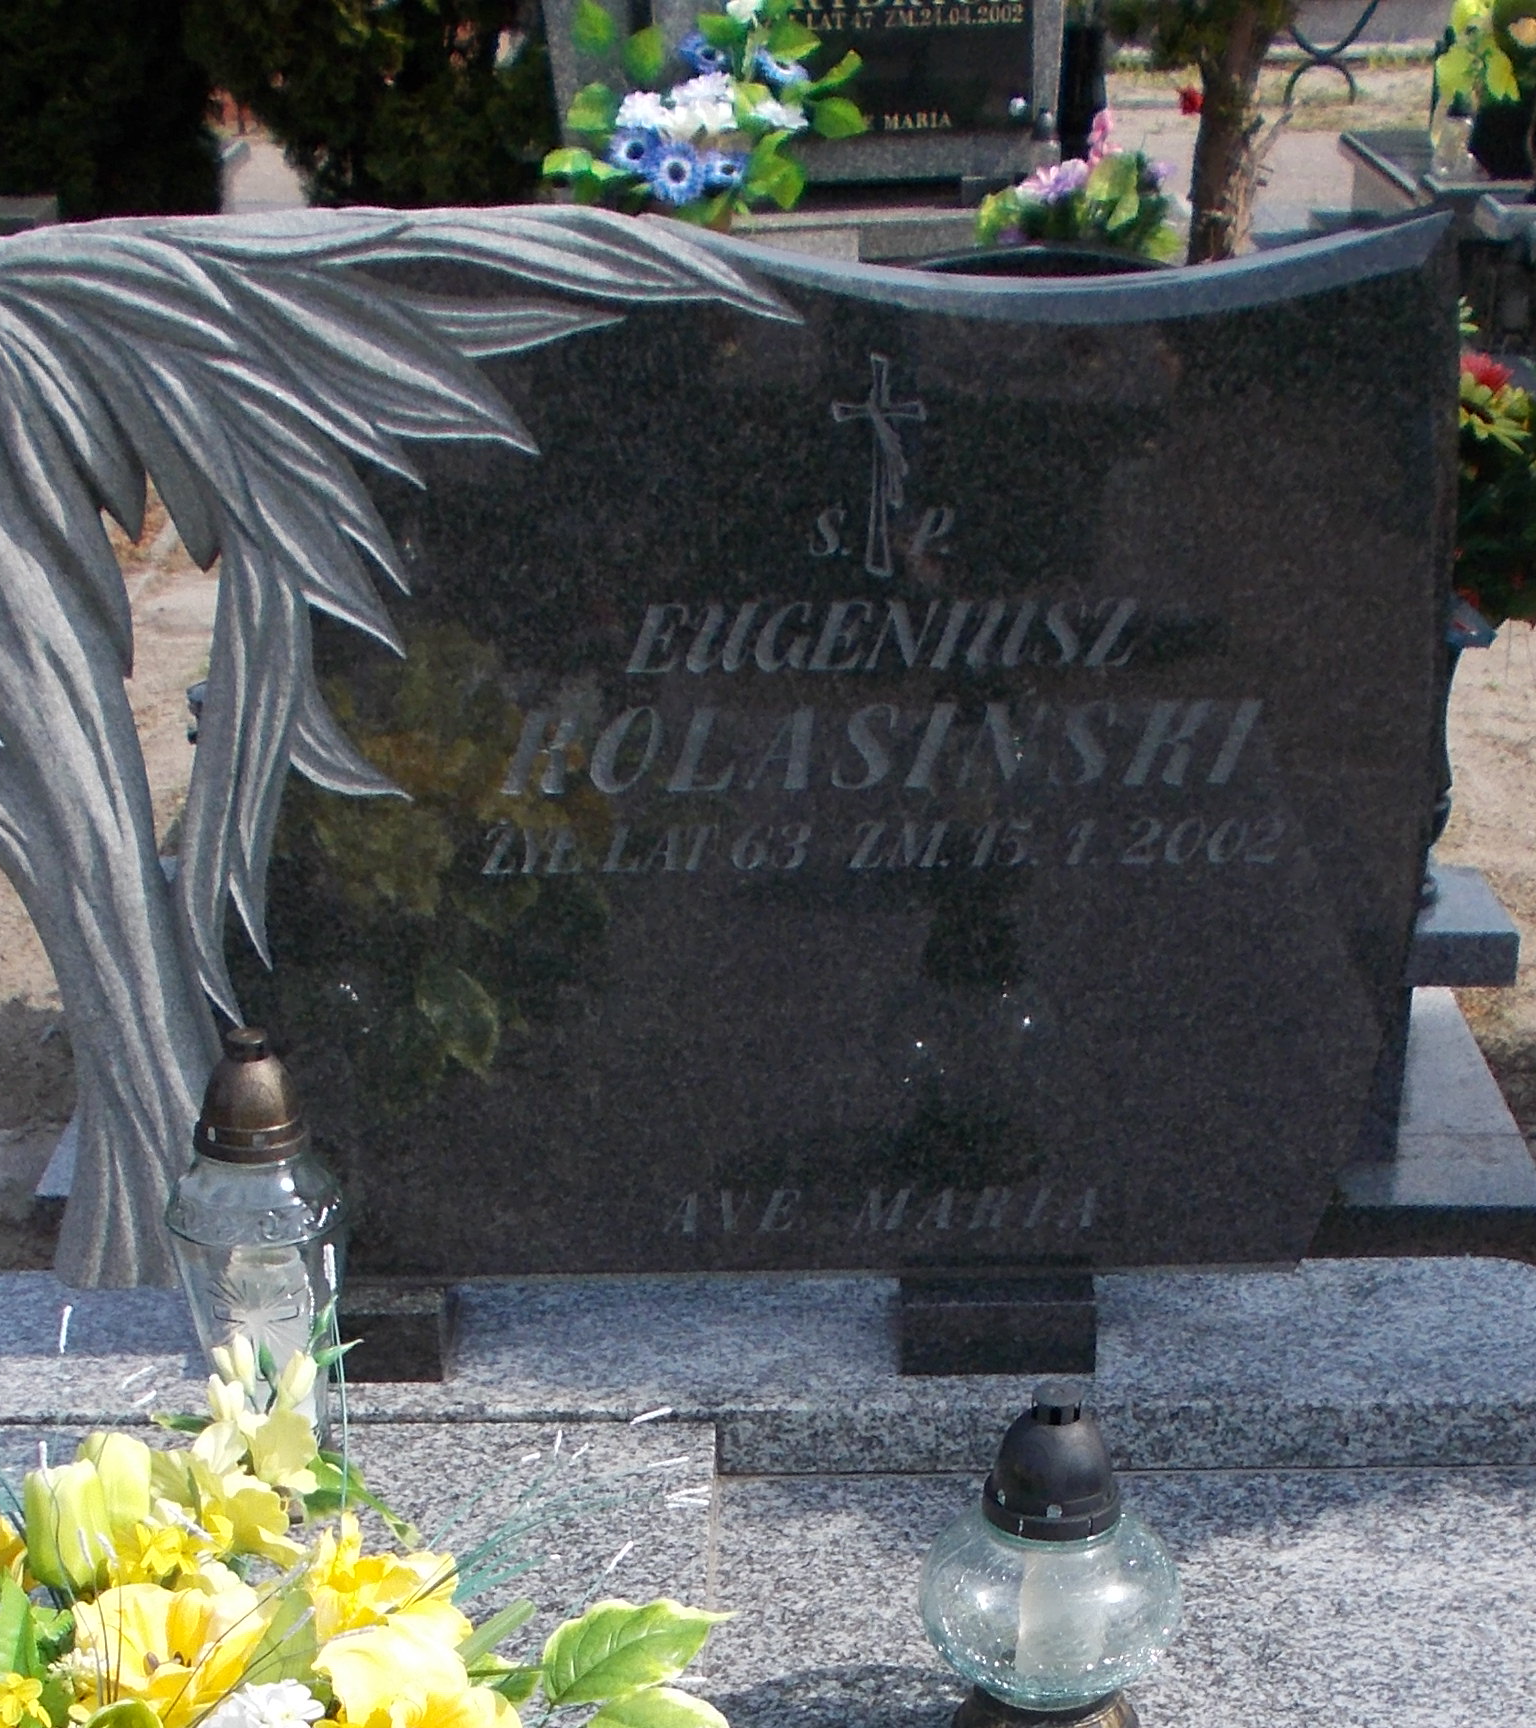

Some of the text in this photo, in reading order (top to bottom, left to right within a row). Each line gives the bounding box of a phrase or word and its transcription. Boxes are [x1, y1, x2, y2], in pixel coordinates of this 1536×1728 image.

[806, 12, 848, 31] LAT
[884, 111, 953, 130] MARIA
[625, 598, 1142, 676] EUGENIUSZ
[600, 822, 720, 874] LAT
[730, 821, 813, 871] 63
[1120, 811, 1288, 867] 2002
[664, 1186, 1099, 1234] AVE MARIA
